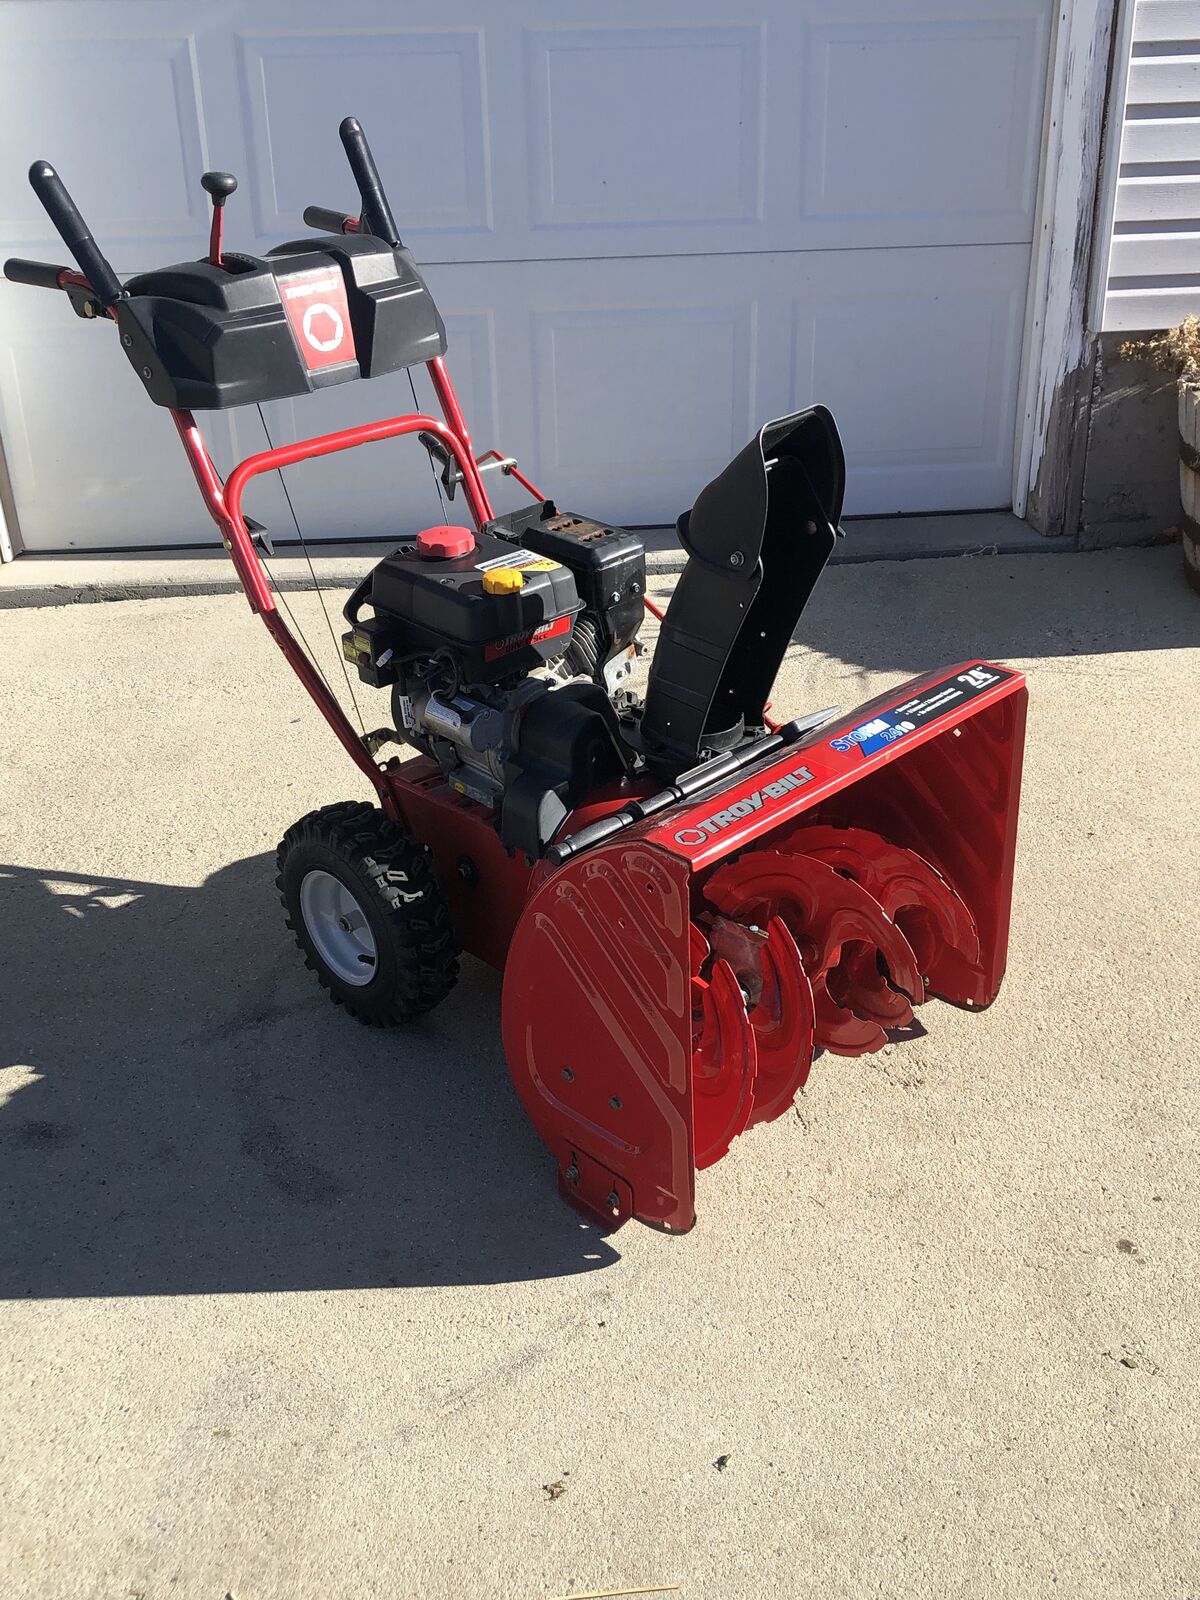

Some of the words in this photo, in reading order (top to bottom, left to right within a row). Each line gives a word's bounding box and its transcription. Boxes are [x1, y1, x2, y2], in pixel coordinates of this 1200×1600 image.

[830, 719, 891, 752] STORM
[880, 721, 916, 742] 2410
[696, 766, 816, 834] TROY-BILT
